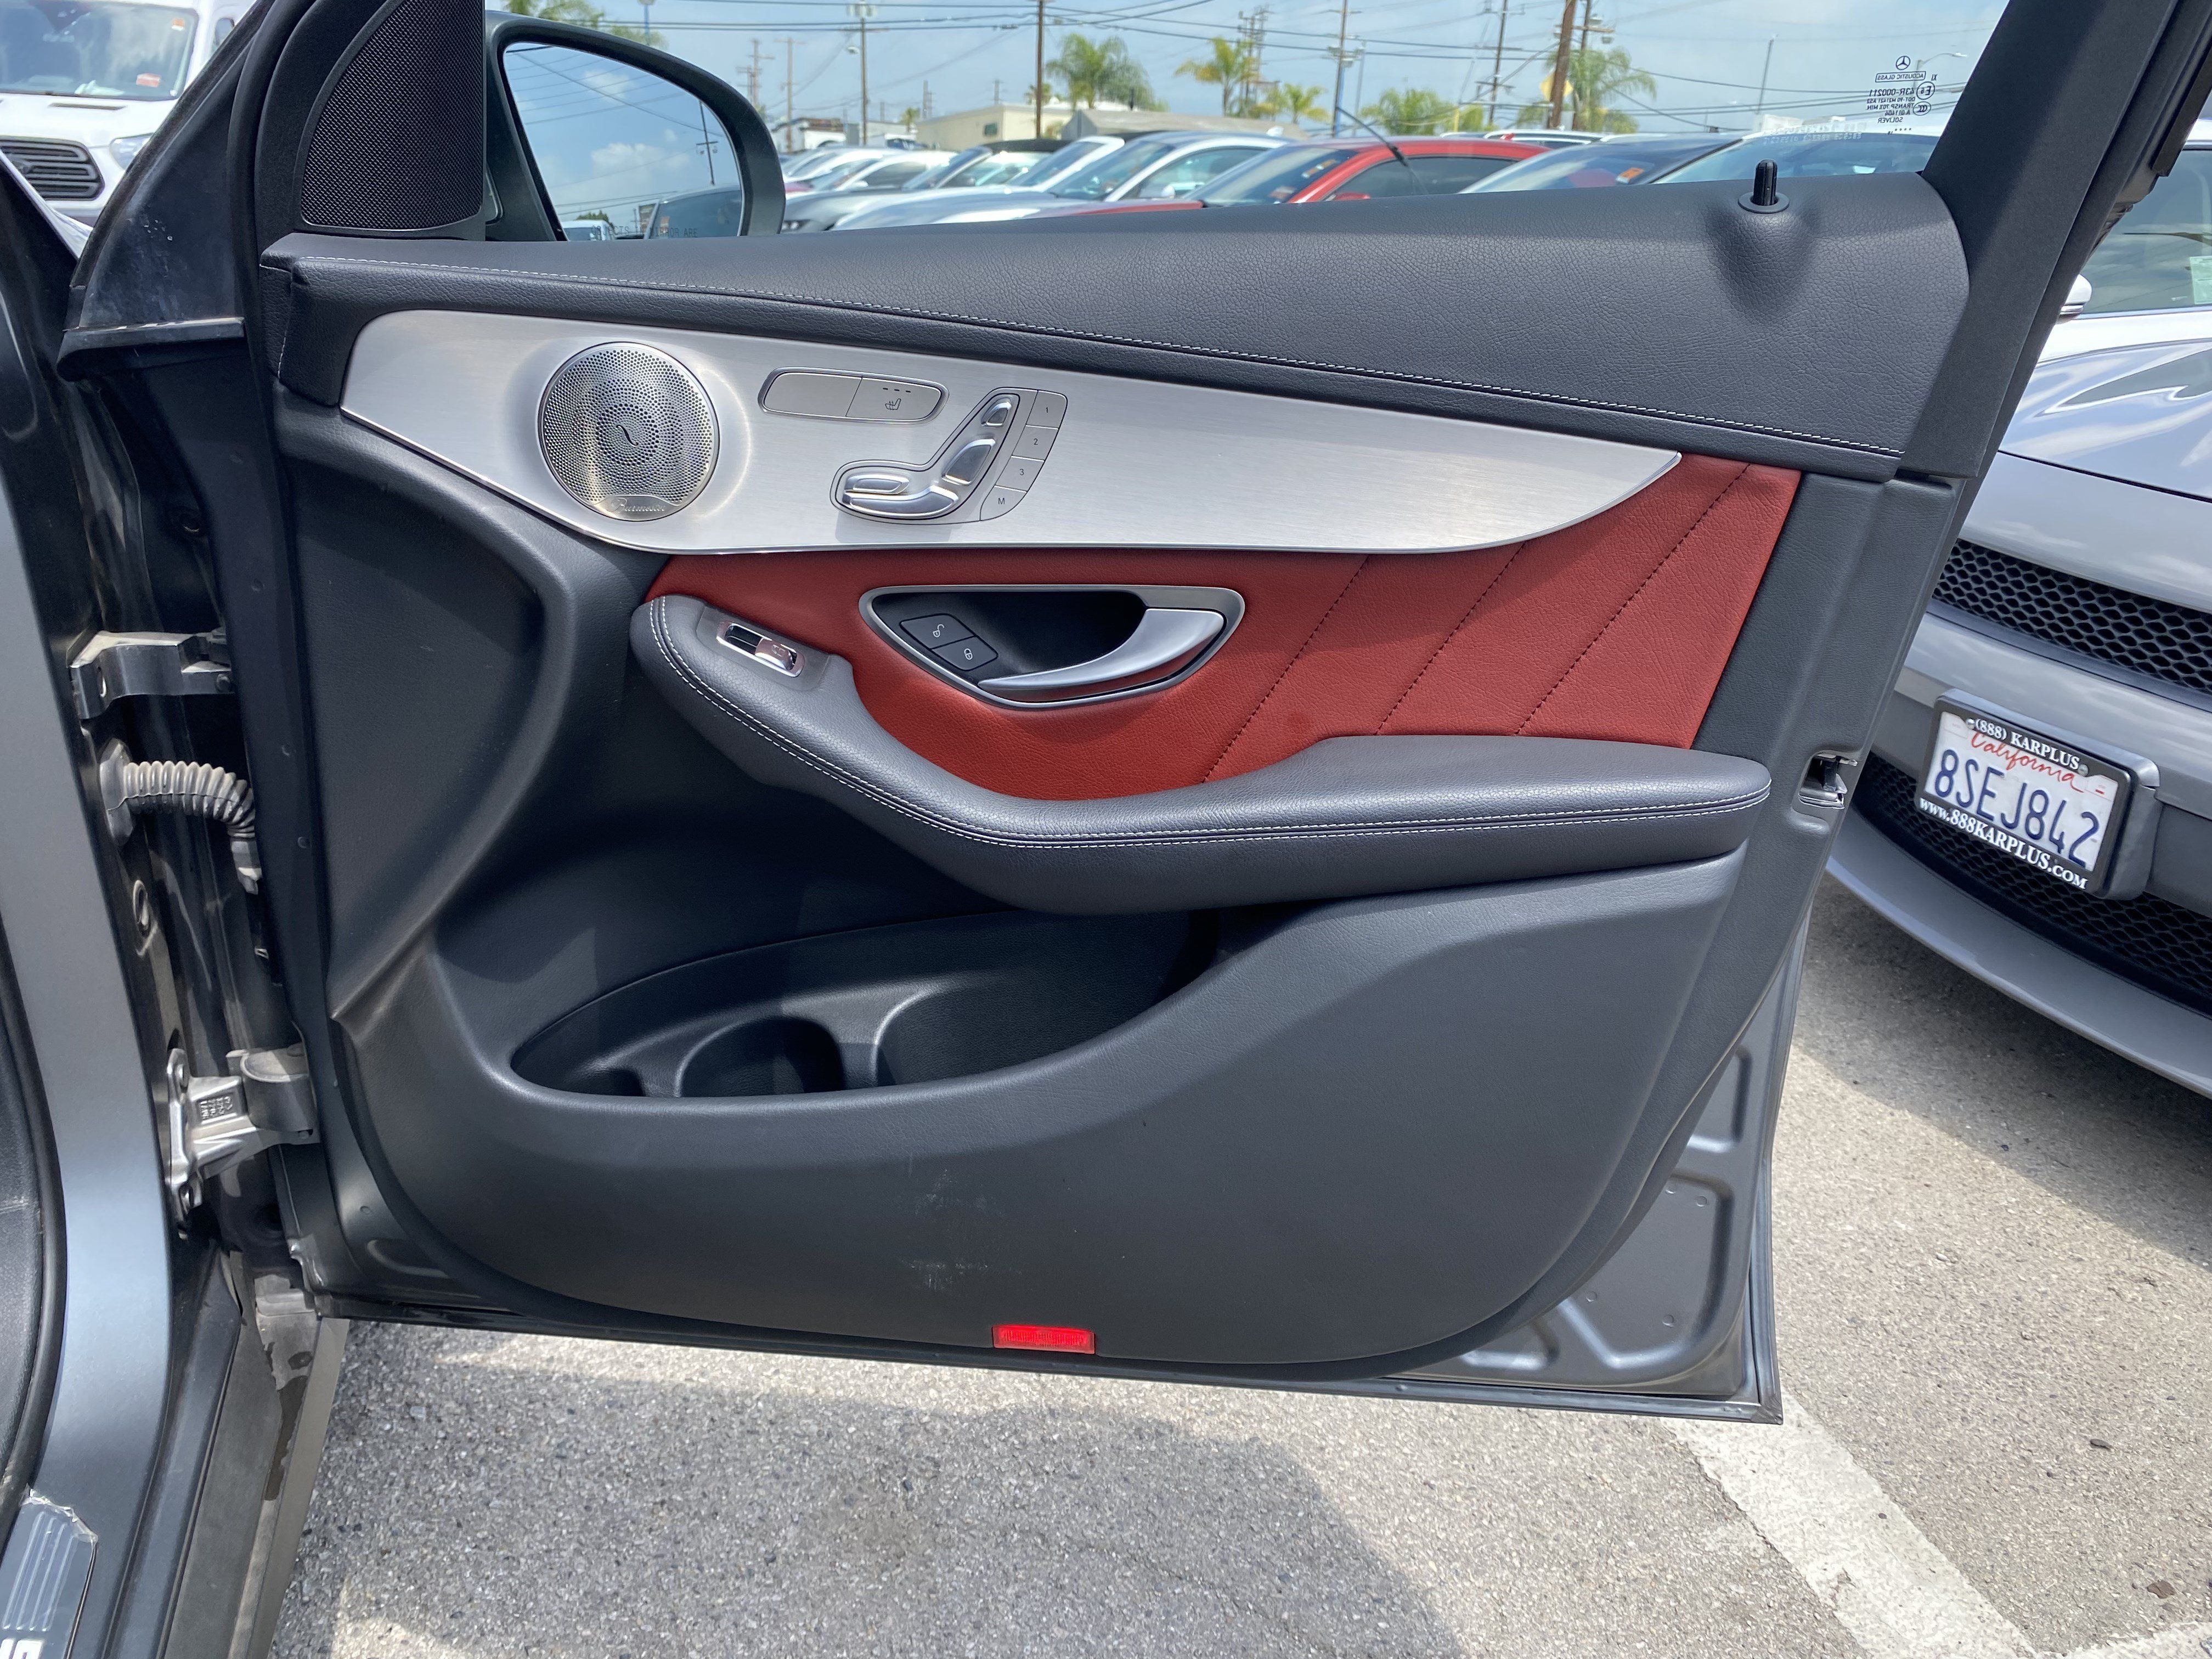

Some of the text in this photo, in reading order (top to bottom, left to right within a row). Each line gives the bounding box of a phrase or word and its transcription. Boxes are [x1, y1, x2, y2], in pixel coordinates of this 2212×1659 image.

[684, 228, 698, 238] ARE
[1971, 732, 2085, 793] California
[1975, 719, 2080, 770] (888) KARPLUS
[1934, 748, 2100, 868] 8SEJ842
